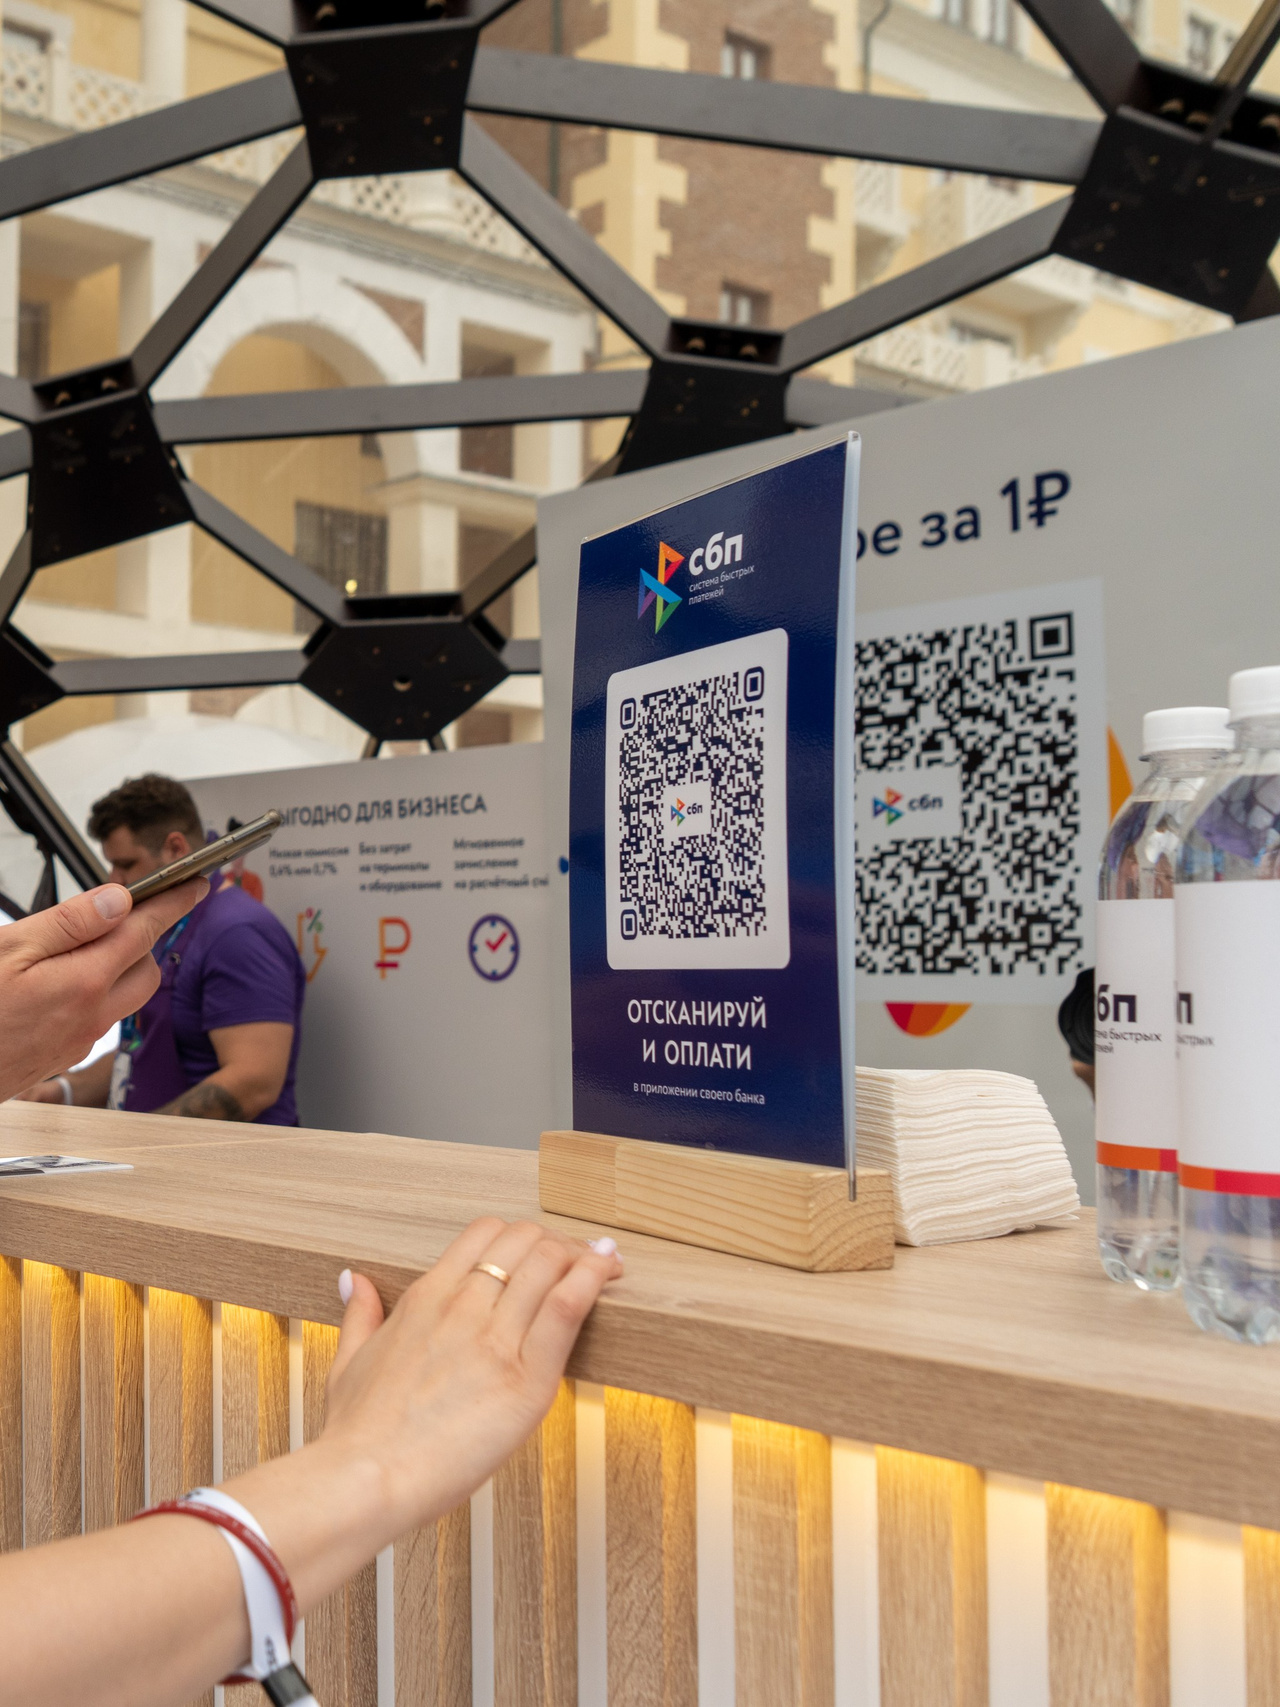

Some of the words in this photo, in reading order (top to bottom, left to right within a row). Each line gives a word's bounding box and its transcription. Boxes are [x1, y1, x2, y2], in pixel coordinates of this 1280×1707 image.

[920, 504, 980, 548] за
[688, 531, 743, 576] сбп
[688, 576, 719, 593] система
[721, 565, 755, 583] быстрых
[688, 585, 725, 605] платежей
[279, 804, 351, 827] ЫГОДНО
[355, 799, 393, 824] ДЛЯ
[398, 794, 487, 818] БИЗНЕСА
[686, 802, 703, 815] сбп
[907, 793, 943, 811] сбп
[359, 842, 376, 855] Без
[627, 996, 767, 1029] ОТСКАНИРУЙ
[1096, 984, 1137, 1023] бп
[1109, 1028, 1162, 1044] быстрых
[642, 1038, 656, 1064] И
[664, 1039, 752, 1071] ОПЛАТИ
[633, 1082, 639, 1093] в
[640, 1083, 698, 1098] приложении
[699, 1088, 733, 1102] своего
[734, 1088, 766, 1105] банка
